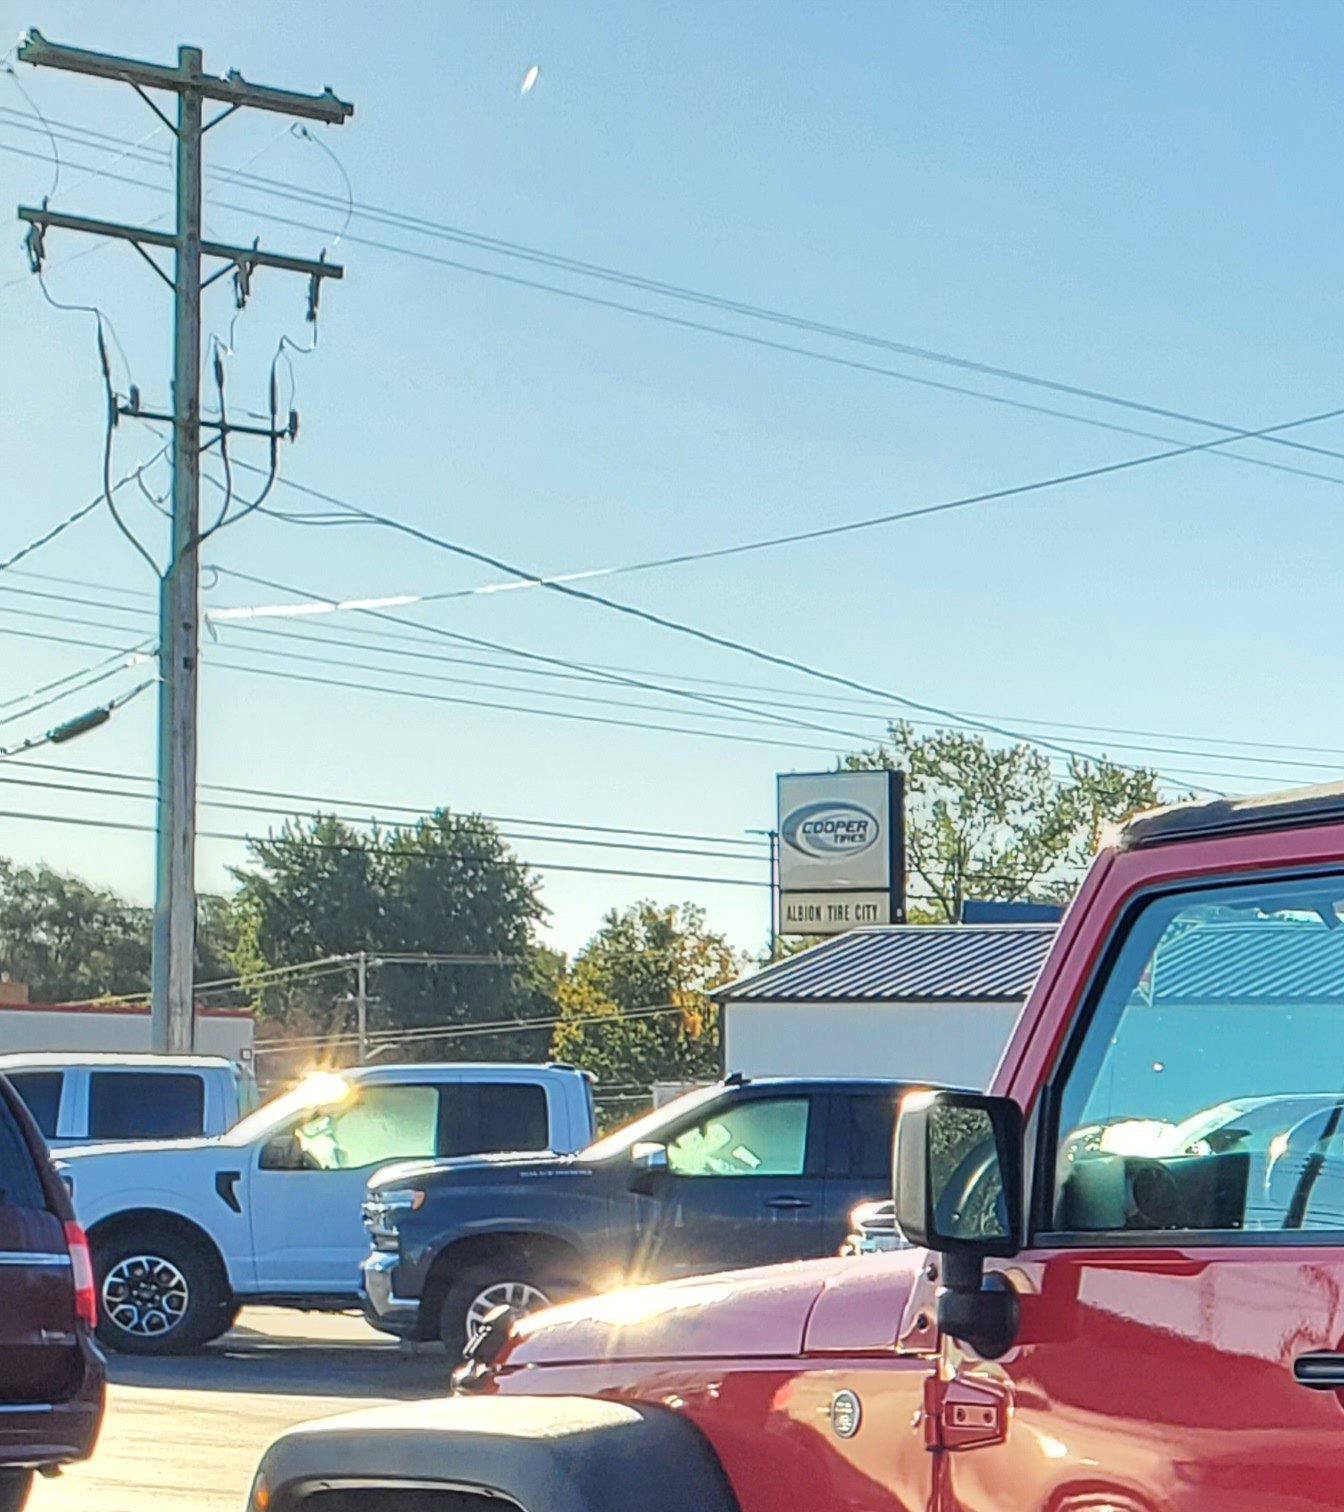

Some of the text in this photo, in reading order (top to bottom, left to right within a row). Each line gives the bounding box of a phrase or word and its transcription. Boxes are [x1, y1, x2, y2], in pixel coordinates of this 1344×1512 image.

[802, 820, 869, 834] COOPER
[833, 834, 867, 844] TIRES
[786, 904, 878, 921] ALBION TIRE CITY
